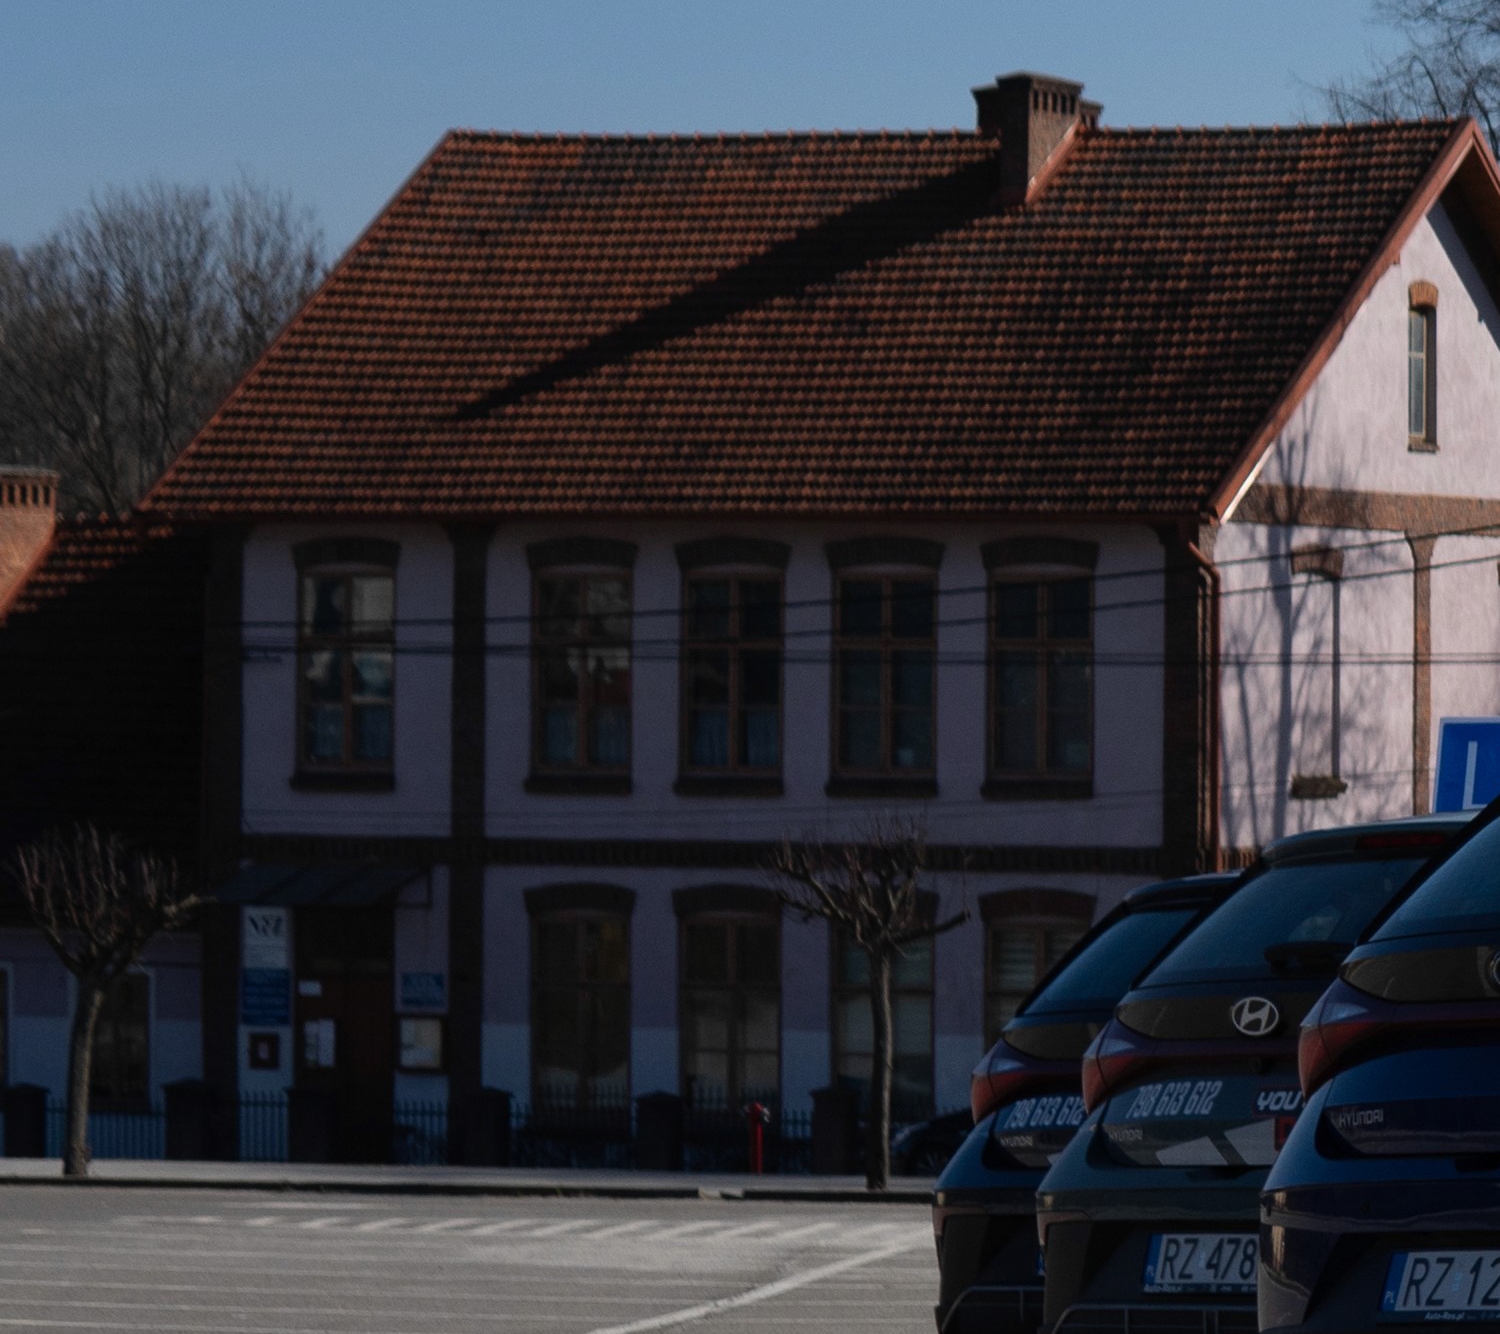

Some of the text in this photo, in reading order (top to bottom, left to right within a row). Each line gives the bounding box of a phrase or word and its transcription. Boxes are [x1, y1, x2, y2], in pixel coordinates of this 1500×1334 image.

[1126, 1080, 1223, 1119] 798 613 612
[1256, 1091, 1301, 1112] YOU
[1338, 1109, 1384, 1128] HYUNDAI
[1161, 1238, 1199, 1280] RZ
[1402, 1257, 1455, 1306] RZ
